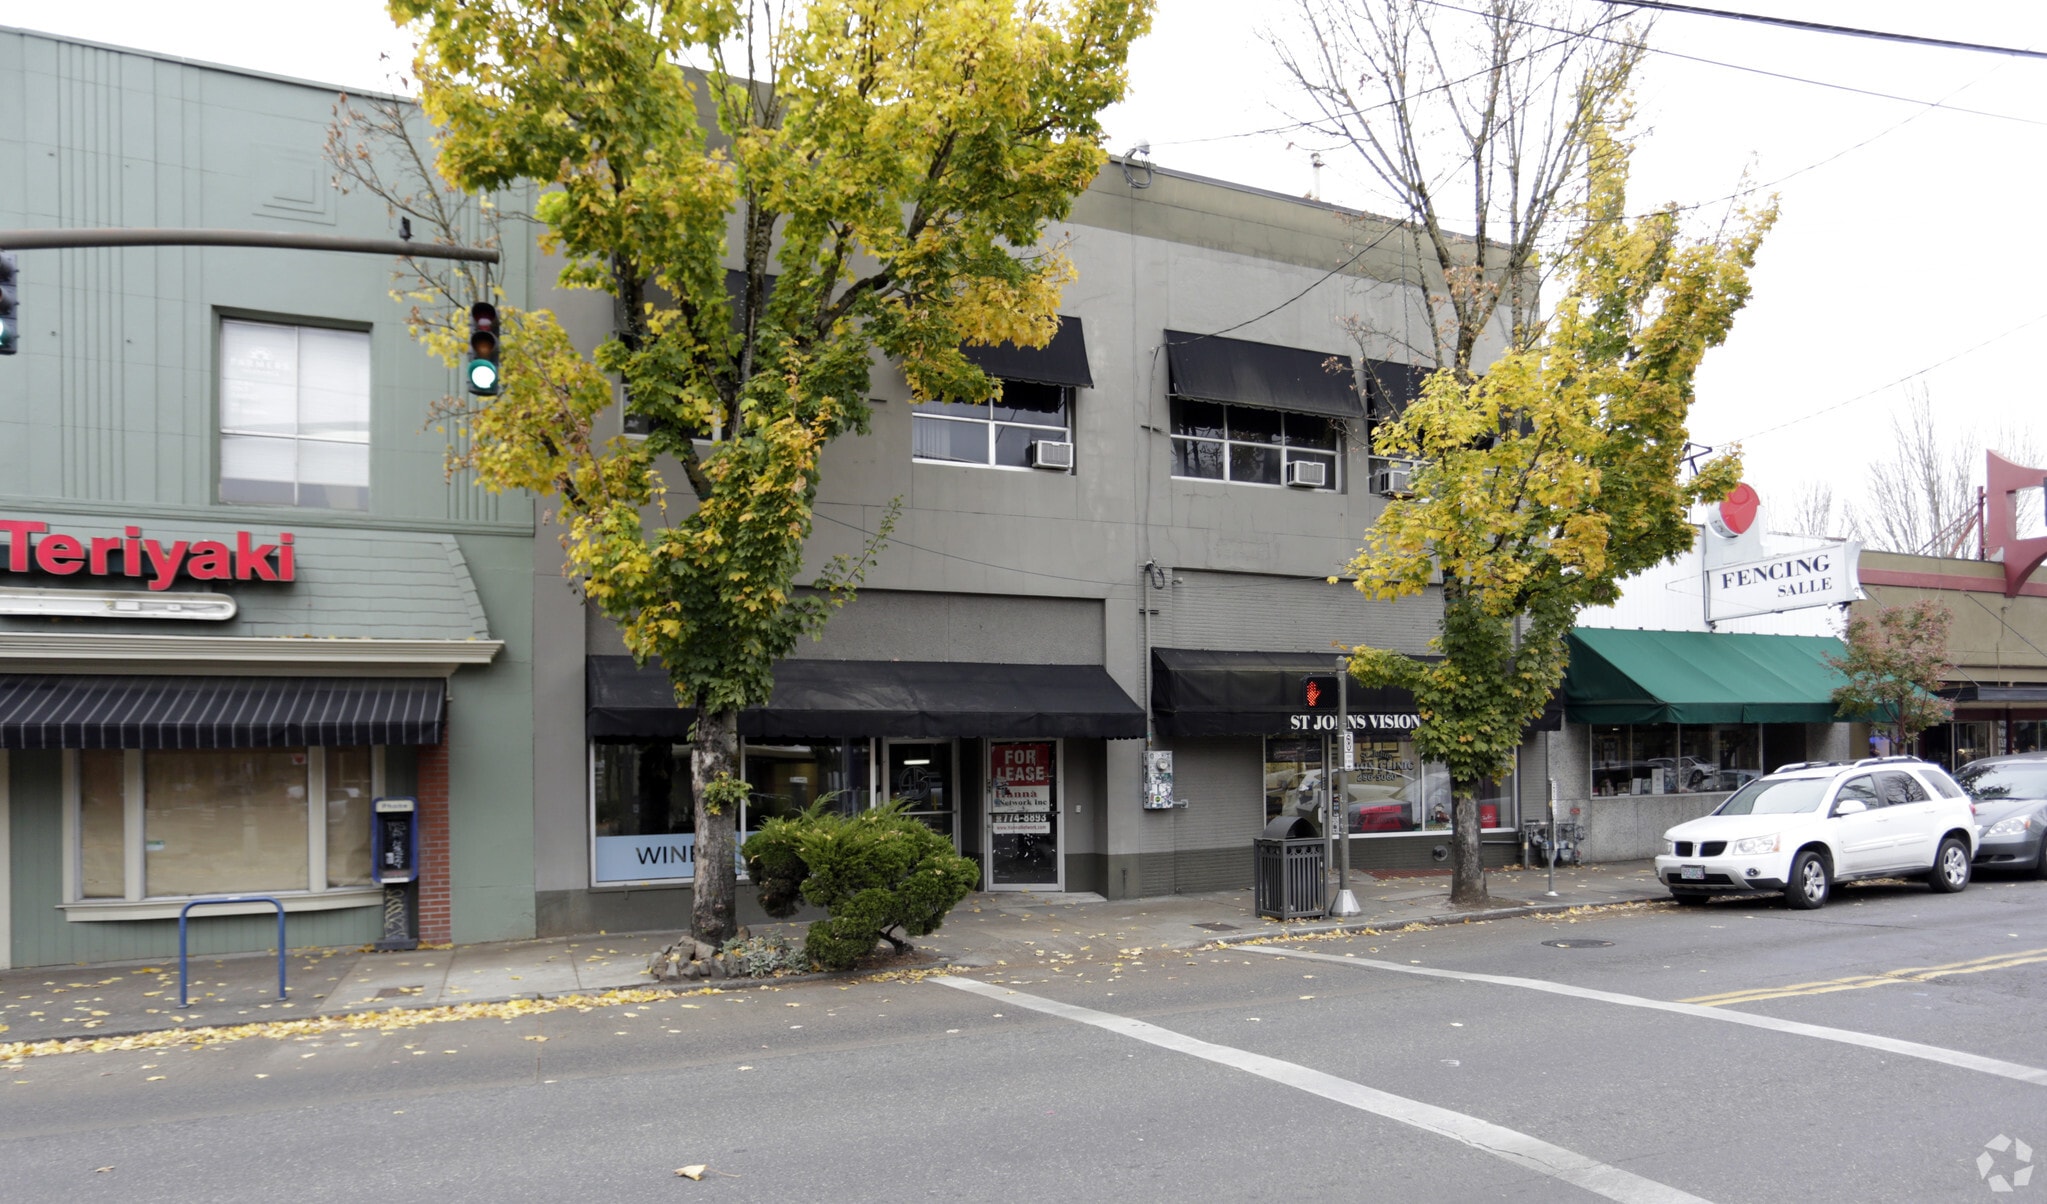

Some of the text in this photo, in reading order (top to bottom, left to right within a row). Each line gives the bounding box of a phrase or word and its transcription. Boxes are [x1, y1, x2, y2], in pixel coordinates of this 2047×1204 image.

[0, 519, 295, 591] Teriyaki
[1720, 554, 1831, 589] FENCING
[1777, 577, 1833, 598] SALLE
[1290, 714, 1310, 730] ST
[1368, 713, 1421, 729] VISION
[1004, 749, 1036, 765] FOR
[1379, 760, 1414, 771] CLINIC
[996, 766, 1045, 781] LEASE
